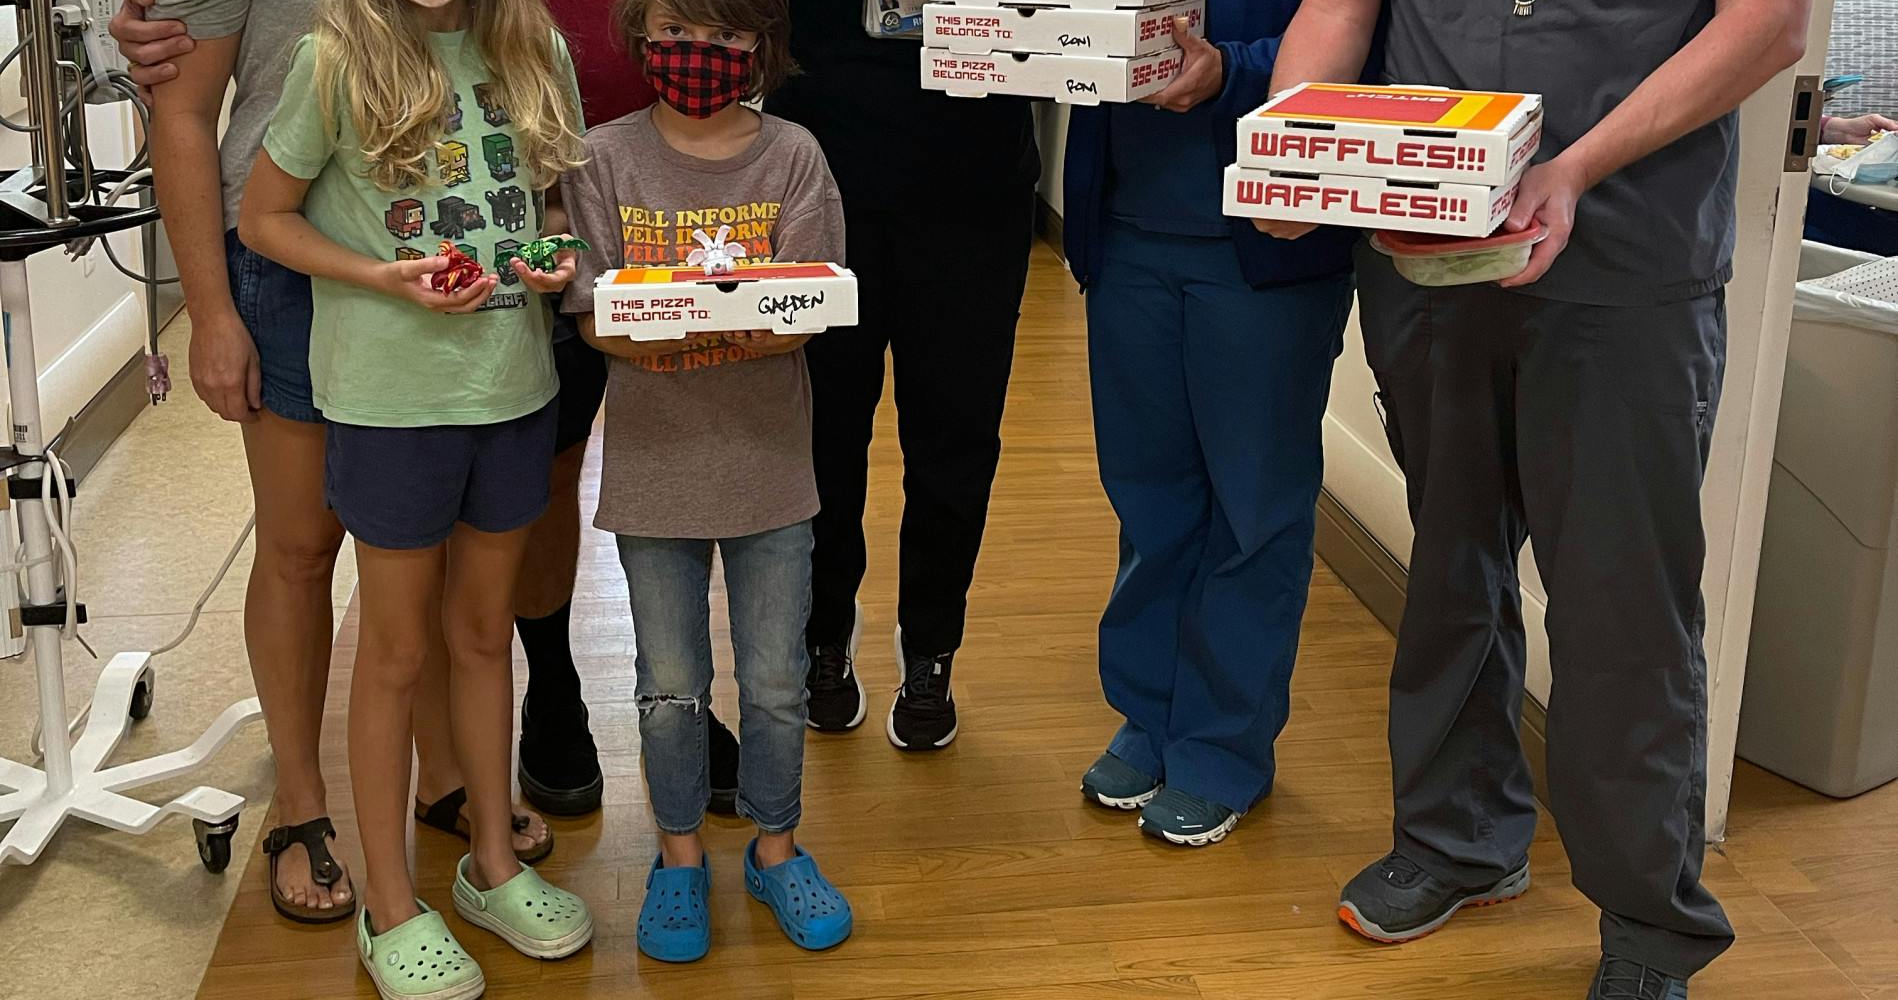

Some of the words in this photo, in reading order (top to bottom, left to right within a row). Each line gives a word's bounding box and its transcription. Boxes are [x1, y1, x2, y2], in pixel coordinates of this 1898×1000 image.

[935, 16, 961, 25] THIS
[965, 17, 1000, 27] PIZZA
[935, 27, 990, 37] BELONGS
[1058, 34, 1091, 48] RONI
[932, 59, 957, 69] THIS
[961, 61, 995, 71] PIZZA
[932, 70, 985, 81] BELONGS
[1251, 132, 1486, 172] WAFFLES!!!
[1236, 180, 1468, 222] WAFFLES!!!
[676, 202, 781, 228] INFORME
[611, 300, 644, 310] THIS
[651, 298, 694, 308] PIZZA
[758, 290, 824, 314] GARDEN
[611, 311, 681, 322] BELONGS
